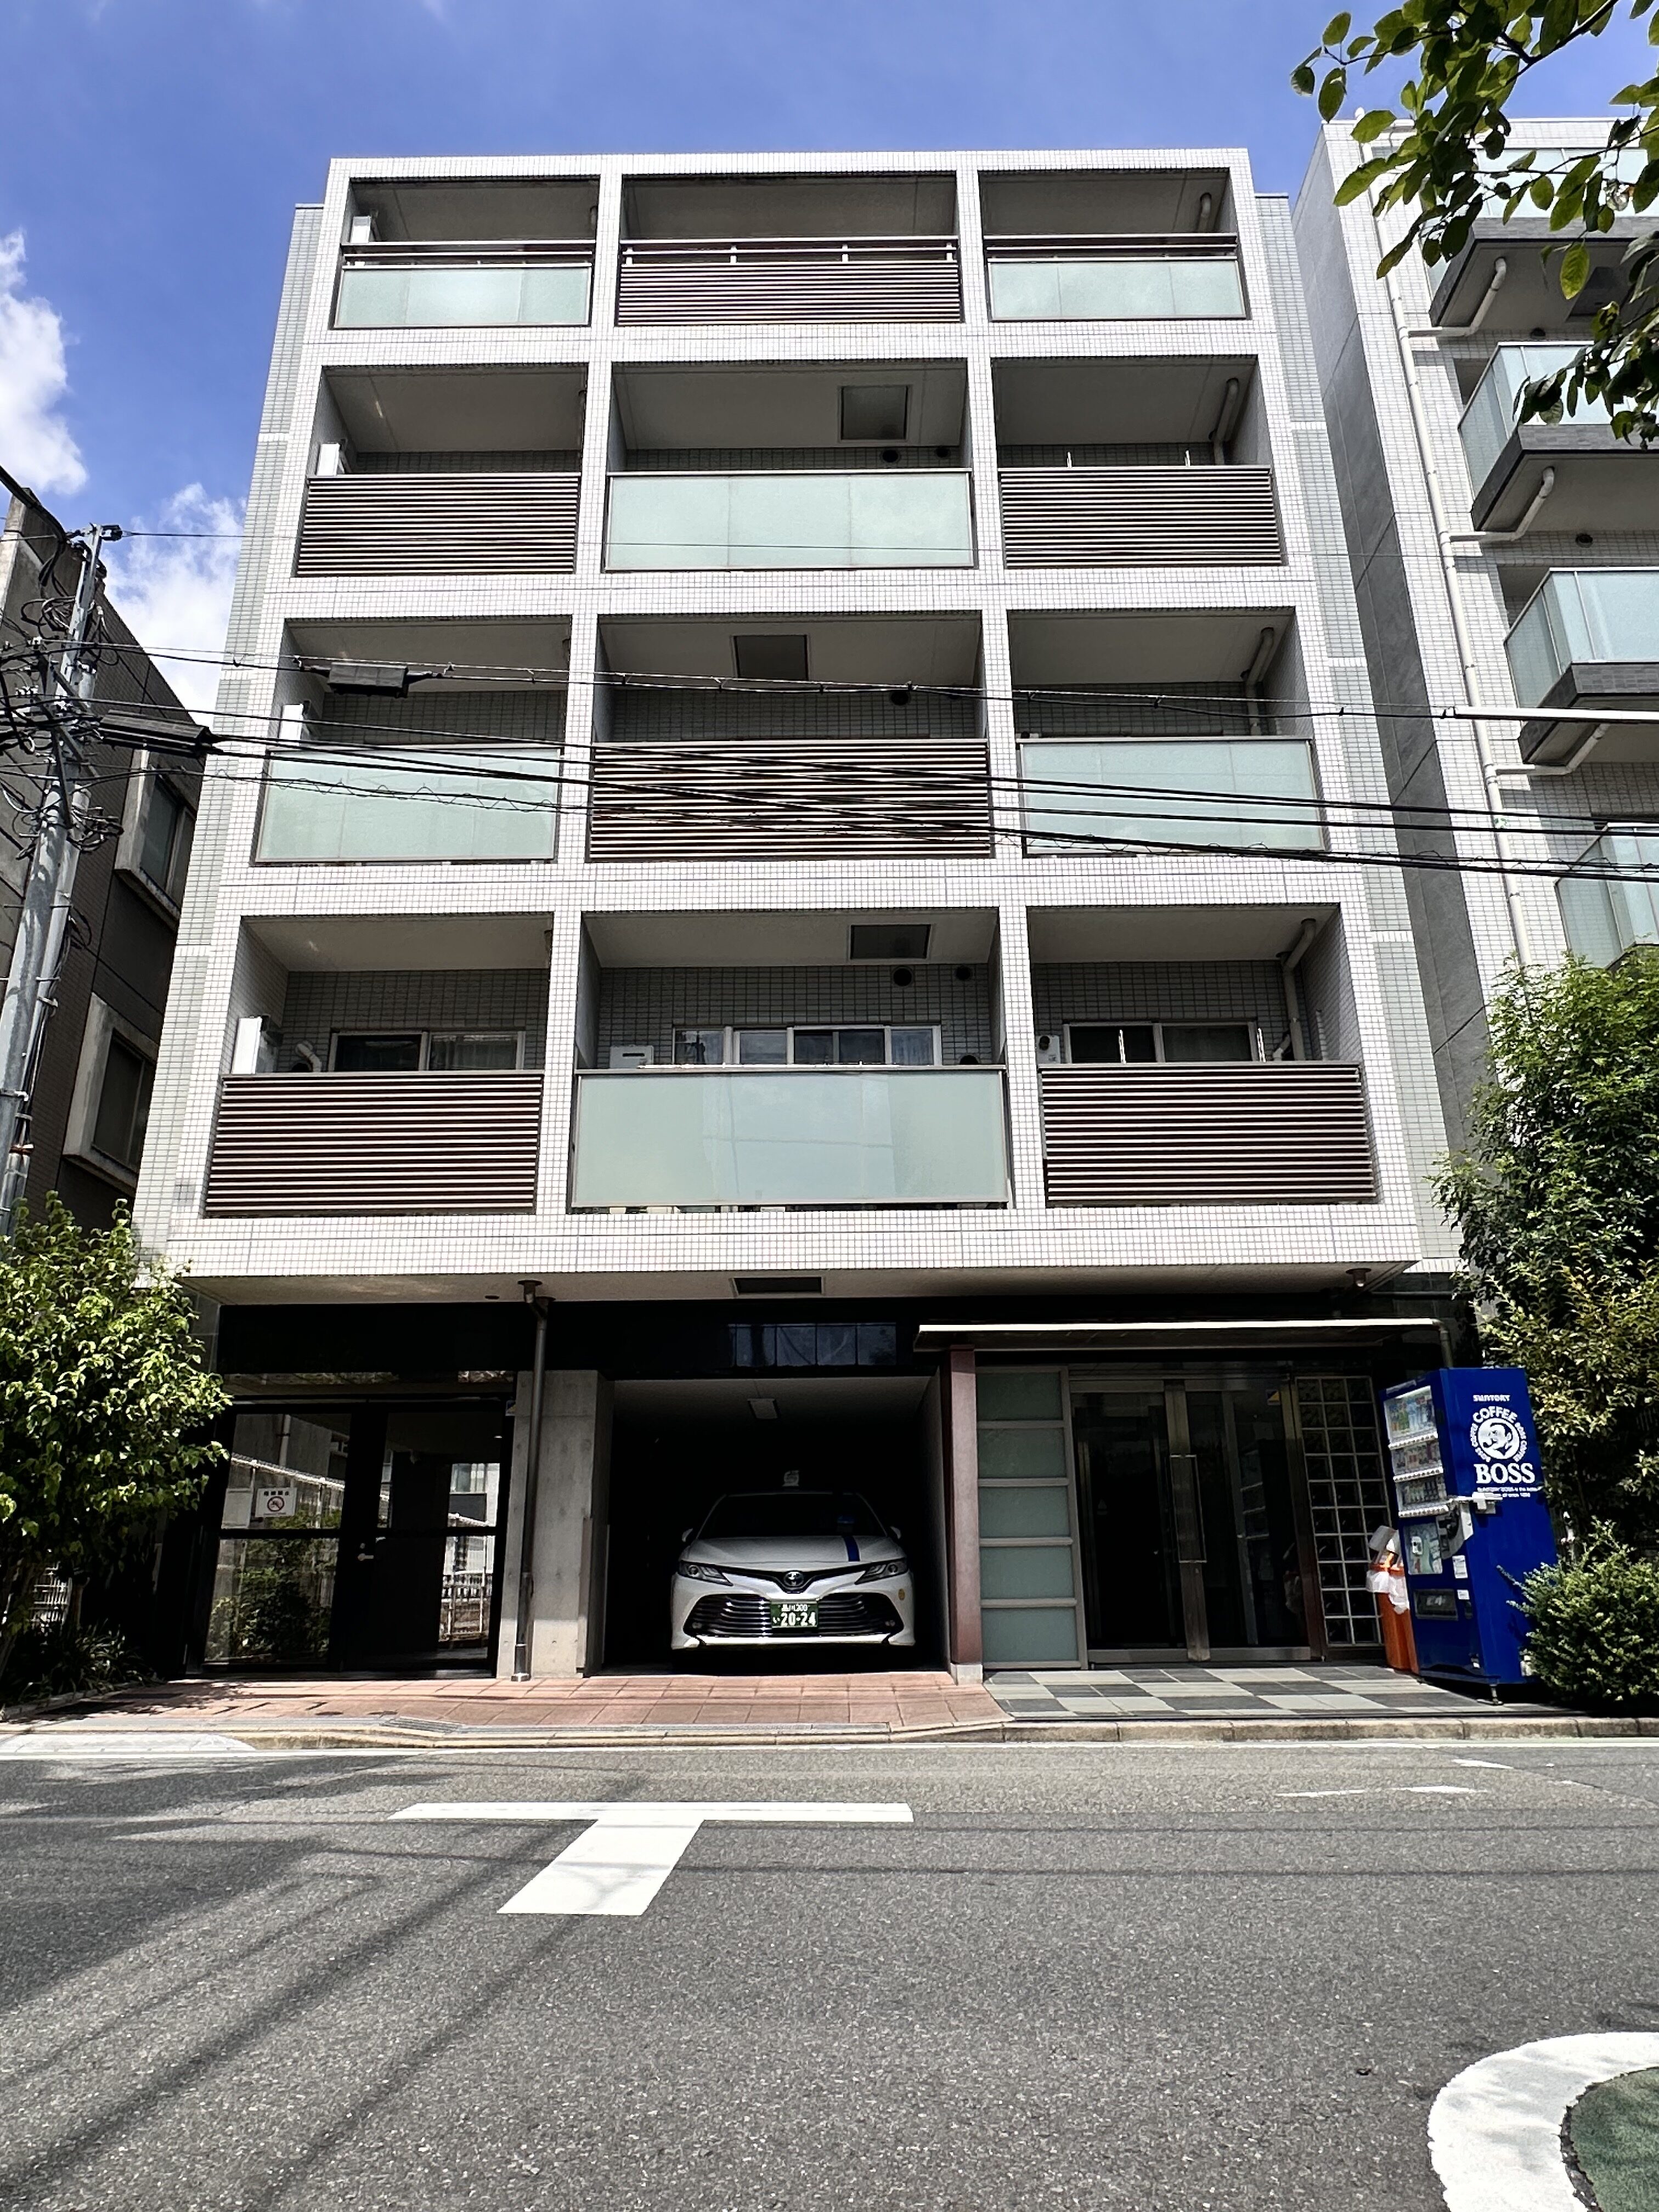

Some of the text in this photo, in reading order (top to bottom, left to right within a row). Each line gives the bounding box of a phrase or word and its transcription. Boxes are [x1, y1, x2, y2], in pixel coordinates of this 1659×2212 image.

[1472, 1406, 1518, 1424] COFFEE
[1474, 1463, 1535, 1483] BOSS
[781, 1612, 816, 1627] 20-24
